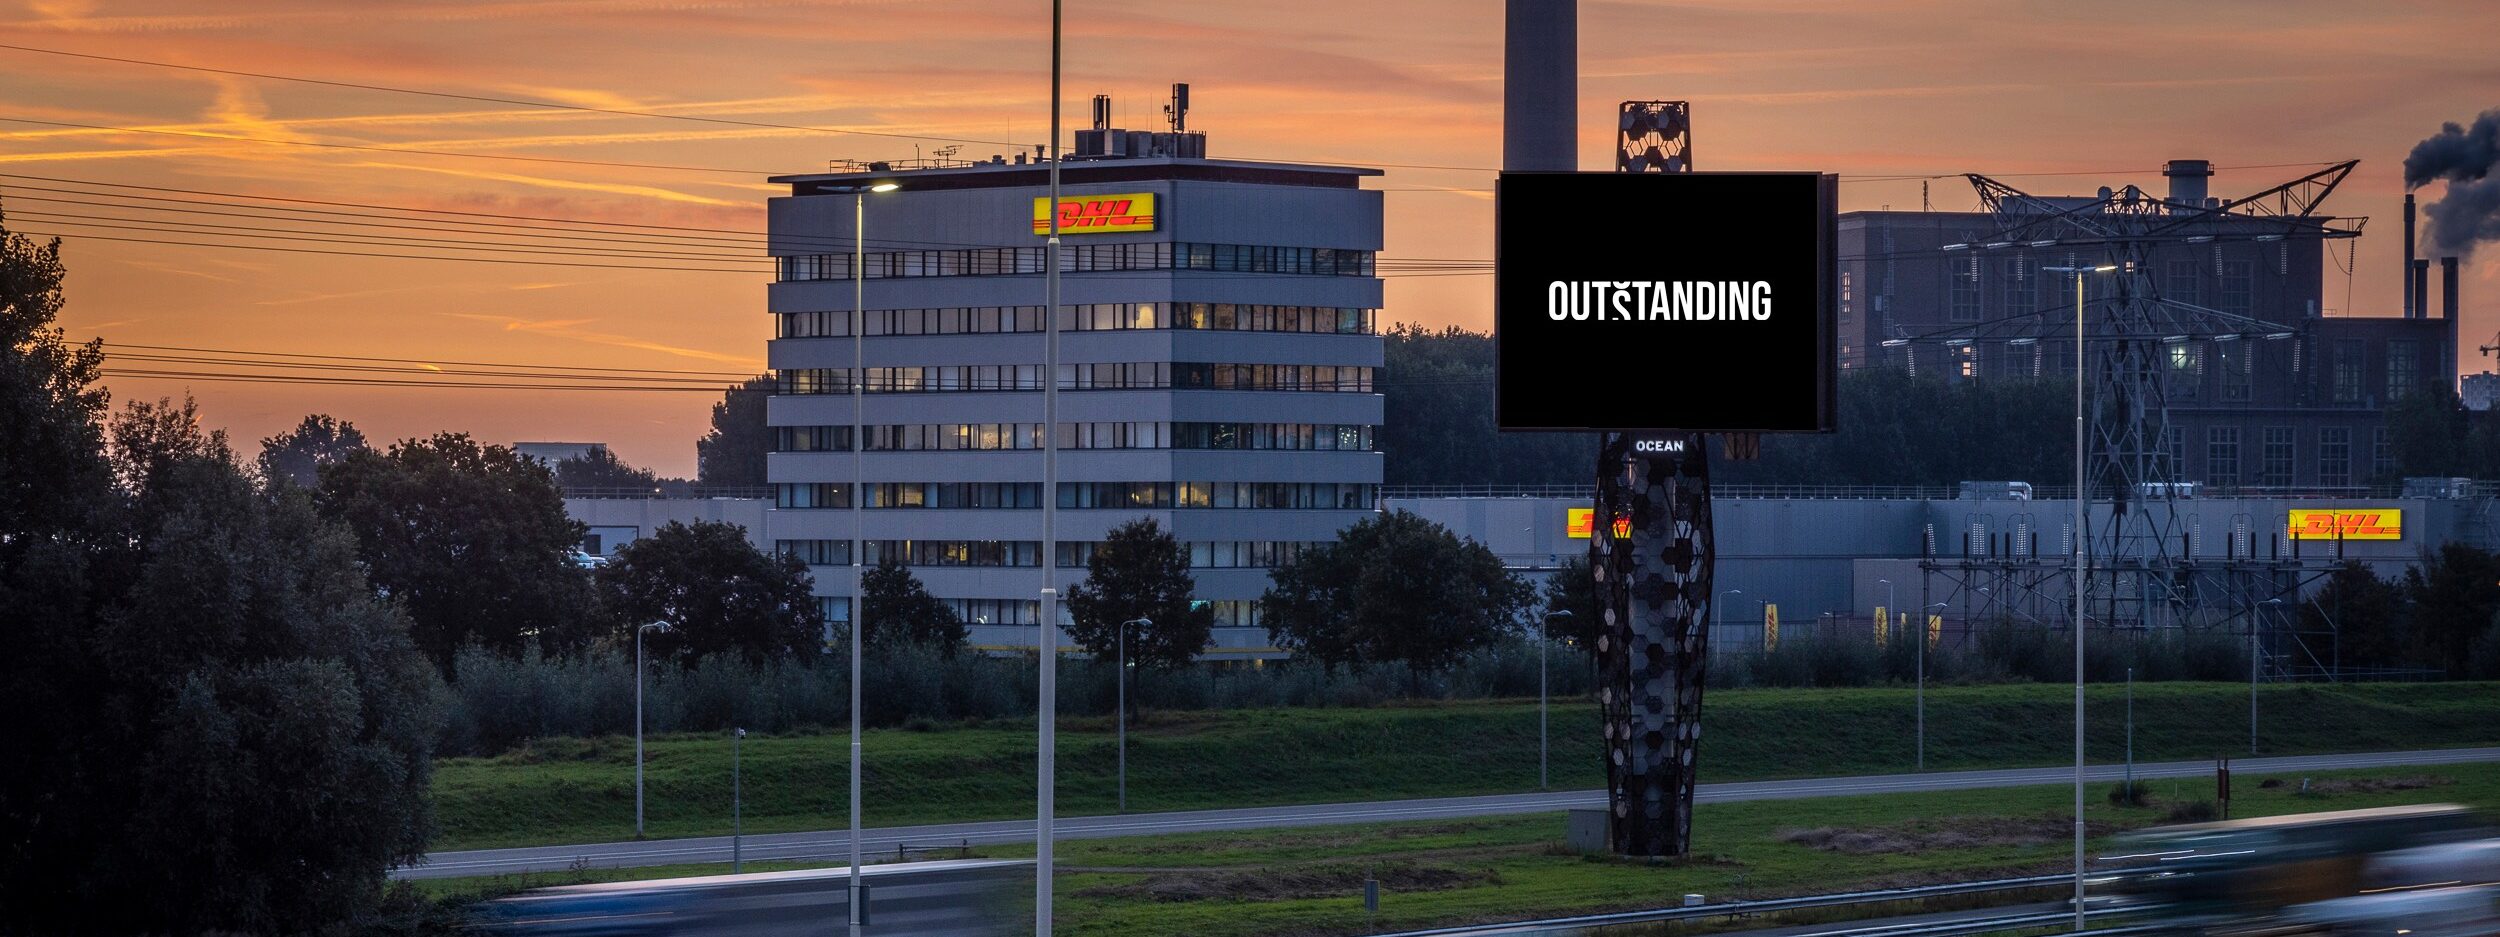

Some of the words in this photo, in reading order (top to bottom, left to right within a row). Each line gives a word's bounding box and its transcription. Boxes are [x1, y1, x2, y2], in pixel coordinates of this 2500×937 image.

[1057, 200, 1136, 227] DHL
[1547, 280, 1772, 321] OUTSTANDING
[1636, 440, 1684, 452] OCEAN
[2304, 514, 2385, 535] DHL
